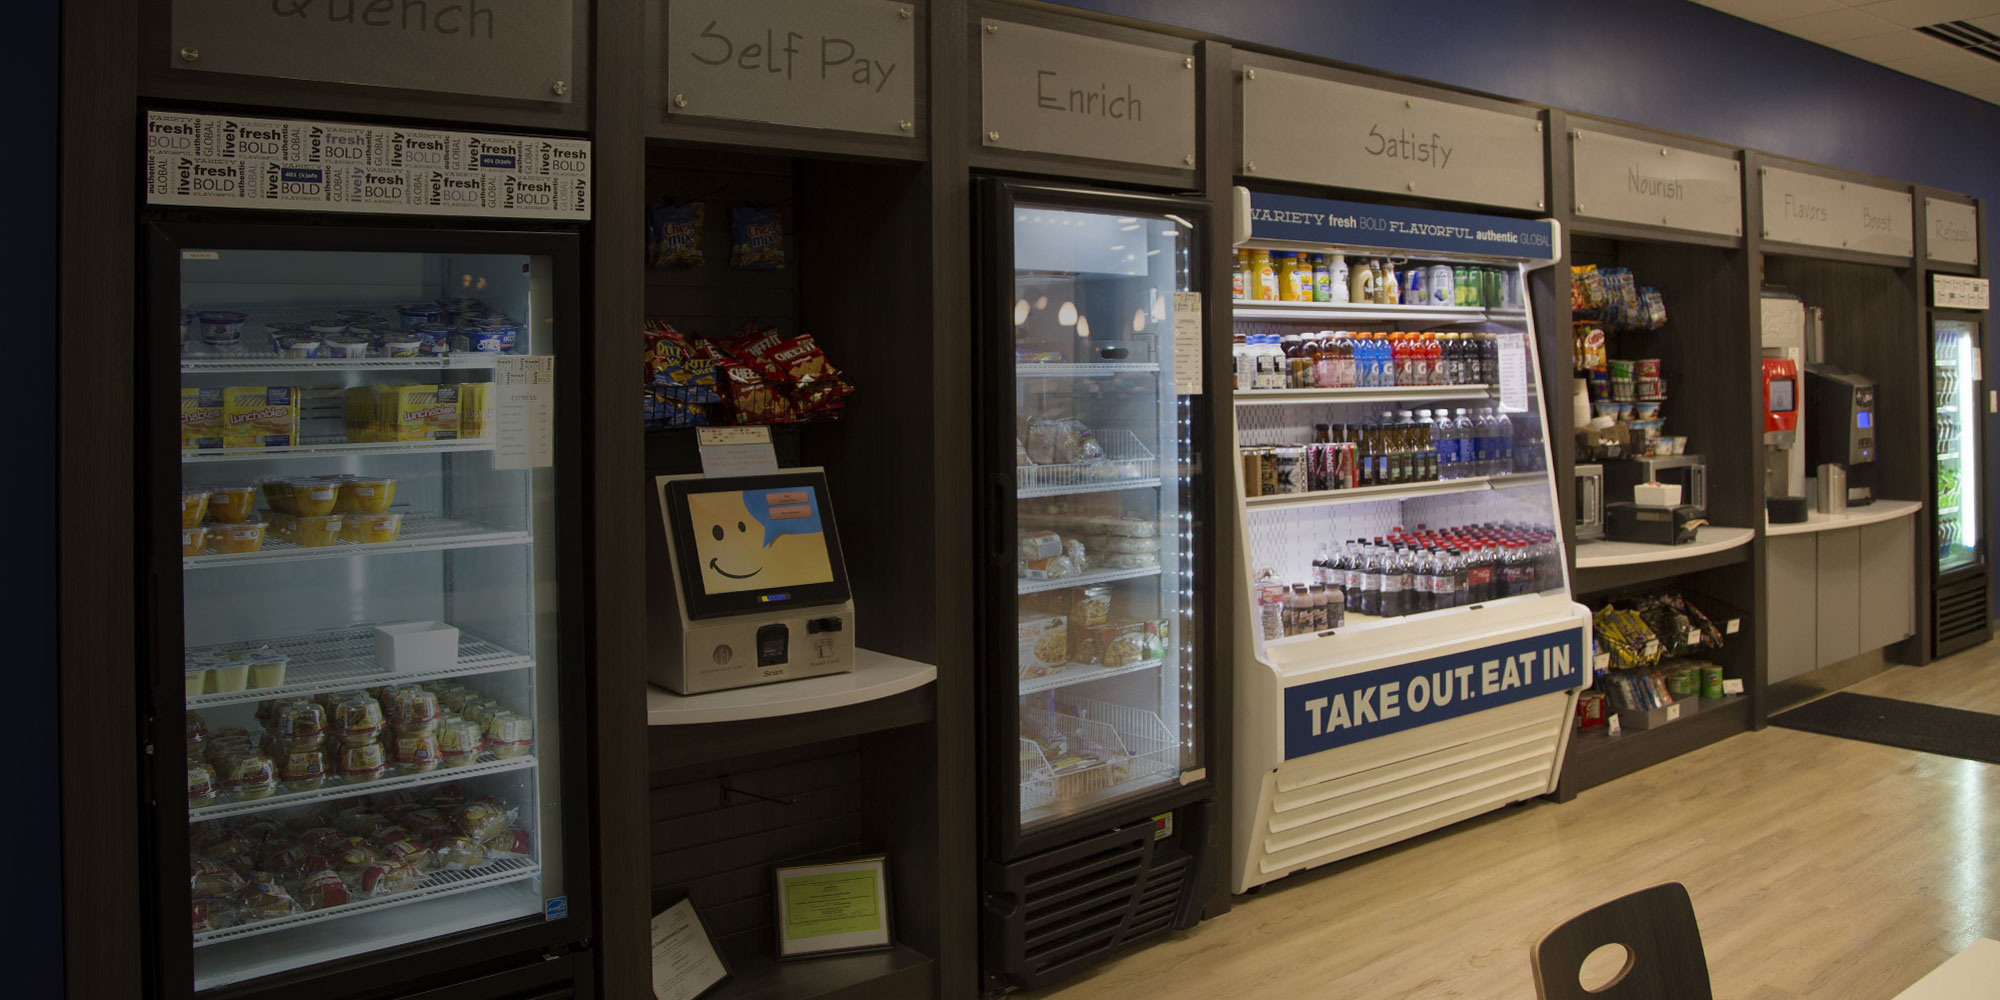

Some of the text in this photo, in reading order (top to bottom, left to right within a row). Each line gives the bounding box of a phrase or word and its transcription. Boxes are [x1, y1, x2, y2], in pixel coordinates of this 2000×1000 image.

[691, 19, 897, 94] Self Pay
[1037, 68, 1143, 123] Enrich
[149, 122, 193, 135] fresh
[149, 136, 190, 149] BOLD
[204, 121, 214, 157] GLOBAL
[223, 120, 238, 158] lively
[239, 128, 281, 140] fresh
[325, 133, 365, 146] fresh
[406, 138, 443, 150] fresh
[239, 141, 279, 154] BOLD
[290, 128, 300, 162] GLOBAL
[309, 126, 324, 163] lively
[325, 146, 363, 160] BOLD
[374, 132, 383, 166] GLOBAL
[392, 132, 404, 167] lively
[406, 151, 441, 164] BOLD
[452, 138, 460, 170] GLOBAL
[468, 136, 480, 171] lively
[482, 143, 516, 155] fresh
[524, 142, 532, 174] GLOBAL
[540, 142, 552, 175] lively
[553, 148, 586, 159] fresh
[1364, 124, 1453, 170] Satisfy
[158, 158, 168, 195] GLOBAL
[178, 157, 192, 195] lively
[194, 164, 236, 177] fresh
[248, 163, 258, 198] GLOBAL
[266, 162, 280, 199] lively
[365, 173, 404, 186] fresh
[552, 160, 585, 172] BOLD
[194, 178, 235, 192] BOLD
[282, 182, 320, 196] BOLD
[334, 168, 342, 202] GLOBAL
[351, 166, 364, 202] lively
[365, 186, 402, 198] BOLD
[414, 172, 422, 206] GLOBAL
[430, 170, 443, 206] lively
[443, 190, 478, 202] BOLD
[444, 177, 480, 189] fresh
[488, 176, 496, 208] GLOBAL
[504, 174, 516, 209] lively
[516, 180, 551, 192] fresh
[560, 180, 568, 211] GLOBAL
[575, 178, 586, 212] lively
[1627, 166, 1683, 202] Nourish
[516, 193, 550, 205] BOLD
[1783, 192, 1892, 232] Flavors Boost
[664, 221, 693, 238] Chex
[667, 234, 694, 250] mix
[746, 223, 774, 238] Chex
[750, 235, 775, 249] mix
[1250, 208, 1551, 248] VARIETY fresh BOLD FLAVORFUL authentic GLOBAL
[1935, 218, 1969, 244] Refresh
[229, 407, 288, 425] Lunchables
[763, 668, 784, 678] Scan
[1305, 642, 1576, 737] TAKE OUT. EAT IN.
